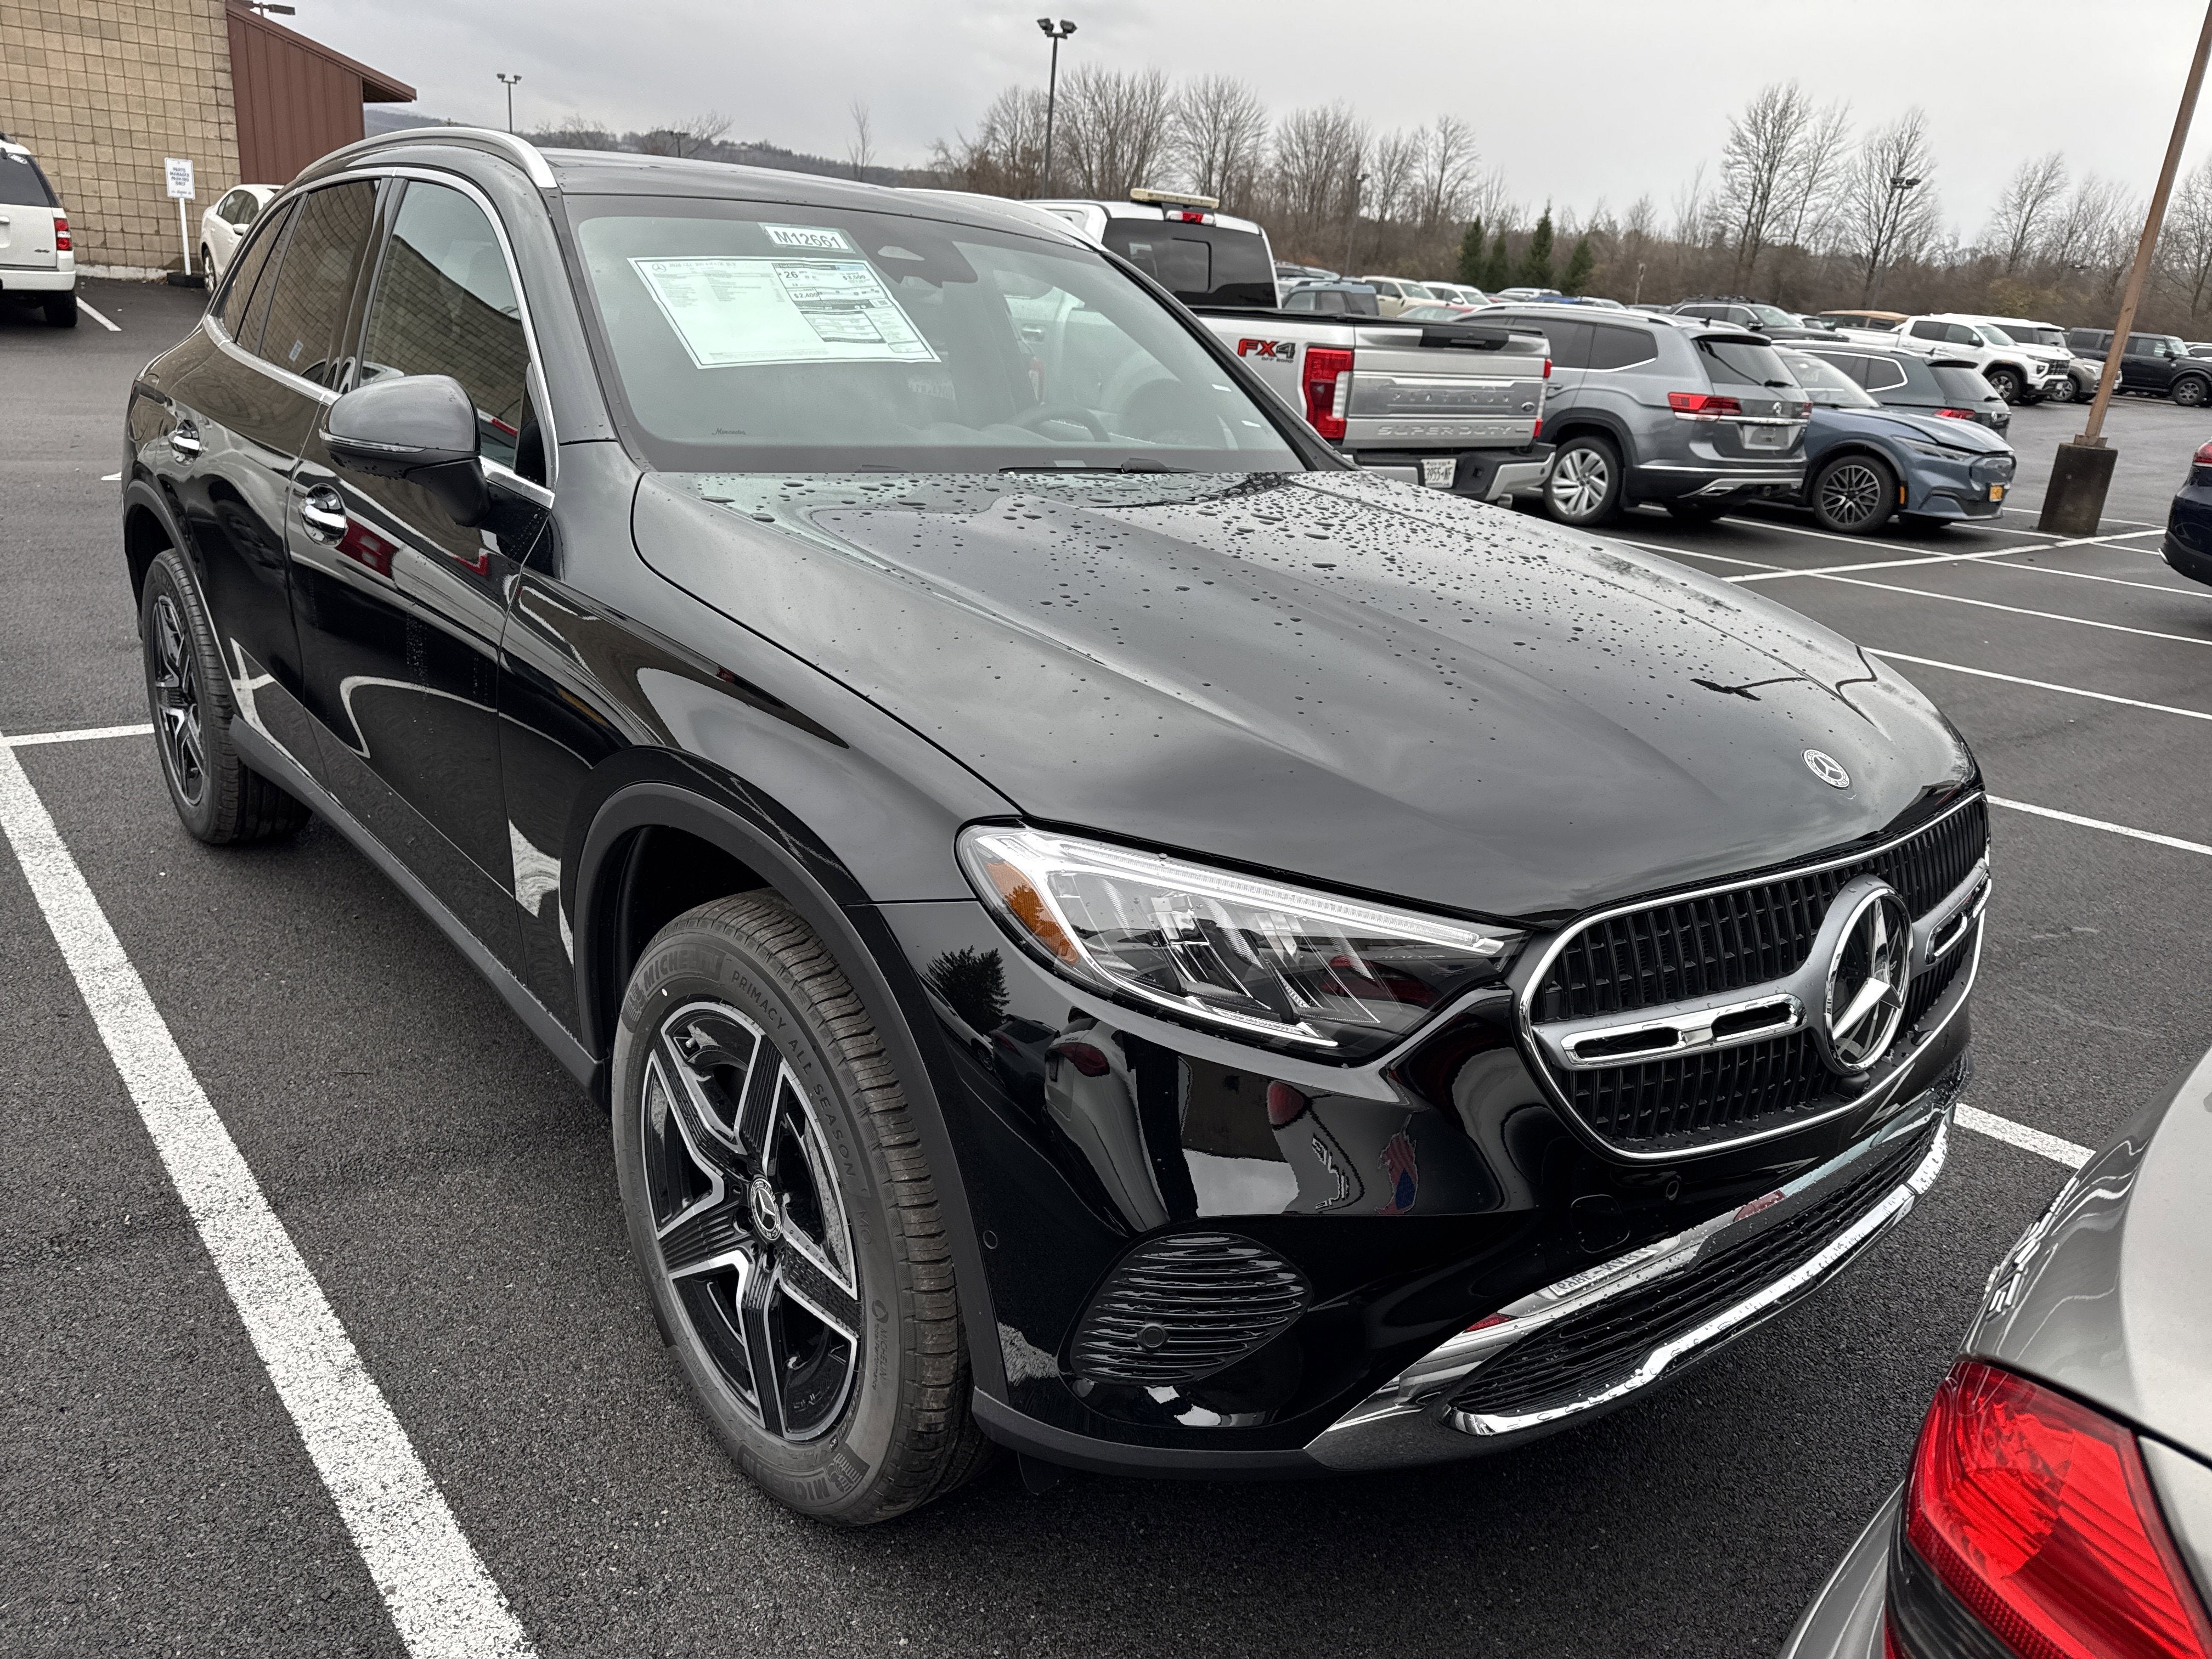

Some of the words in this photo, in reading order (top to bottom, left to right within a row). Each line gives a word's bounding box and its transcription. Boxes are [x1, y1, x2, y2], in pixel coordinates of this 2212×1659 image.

[774, 230, 842, 249] M12661
[1237, 338, 1296, 359] FX4
[1378, 425, 1454, 436] SUPER
[1459, 426, 1511, 436] DUTY
[644, 949, 724, 992] MICHELIN
[731, 970, 787, 1030] PRIMACY
[787, 1039, 813, 1076] ALL
[813, 1082, 856, 1177] SEASON
[879, 1328, 888, 1380] MICHELIN
